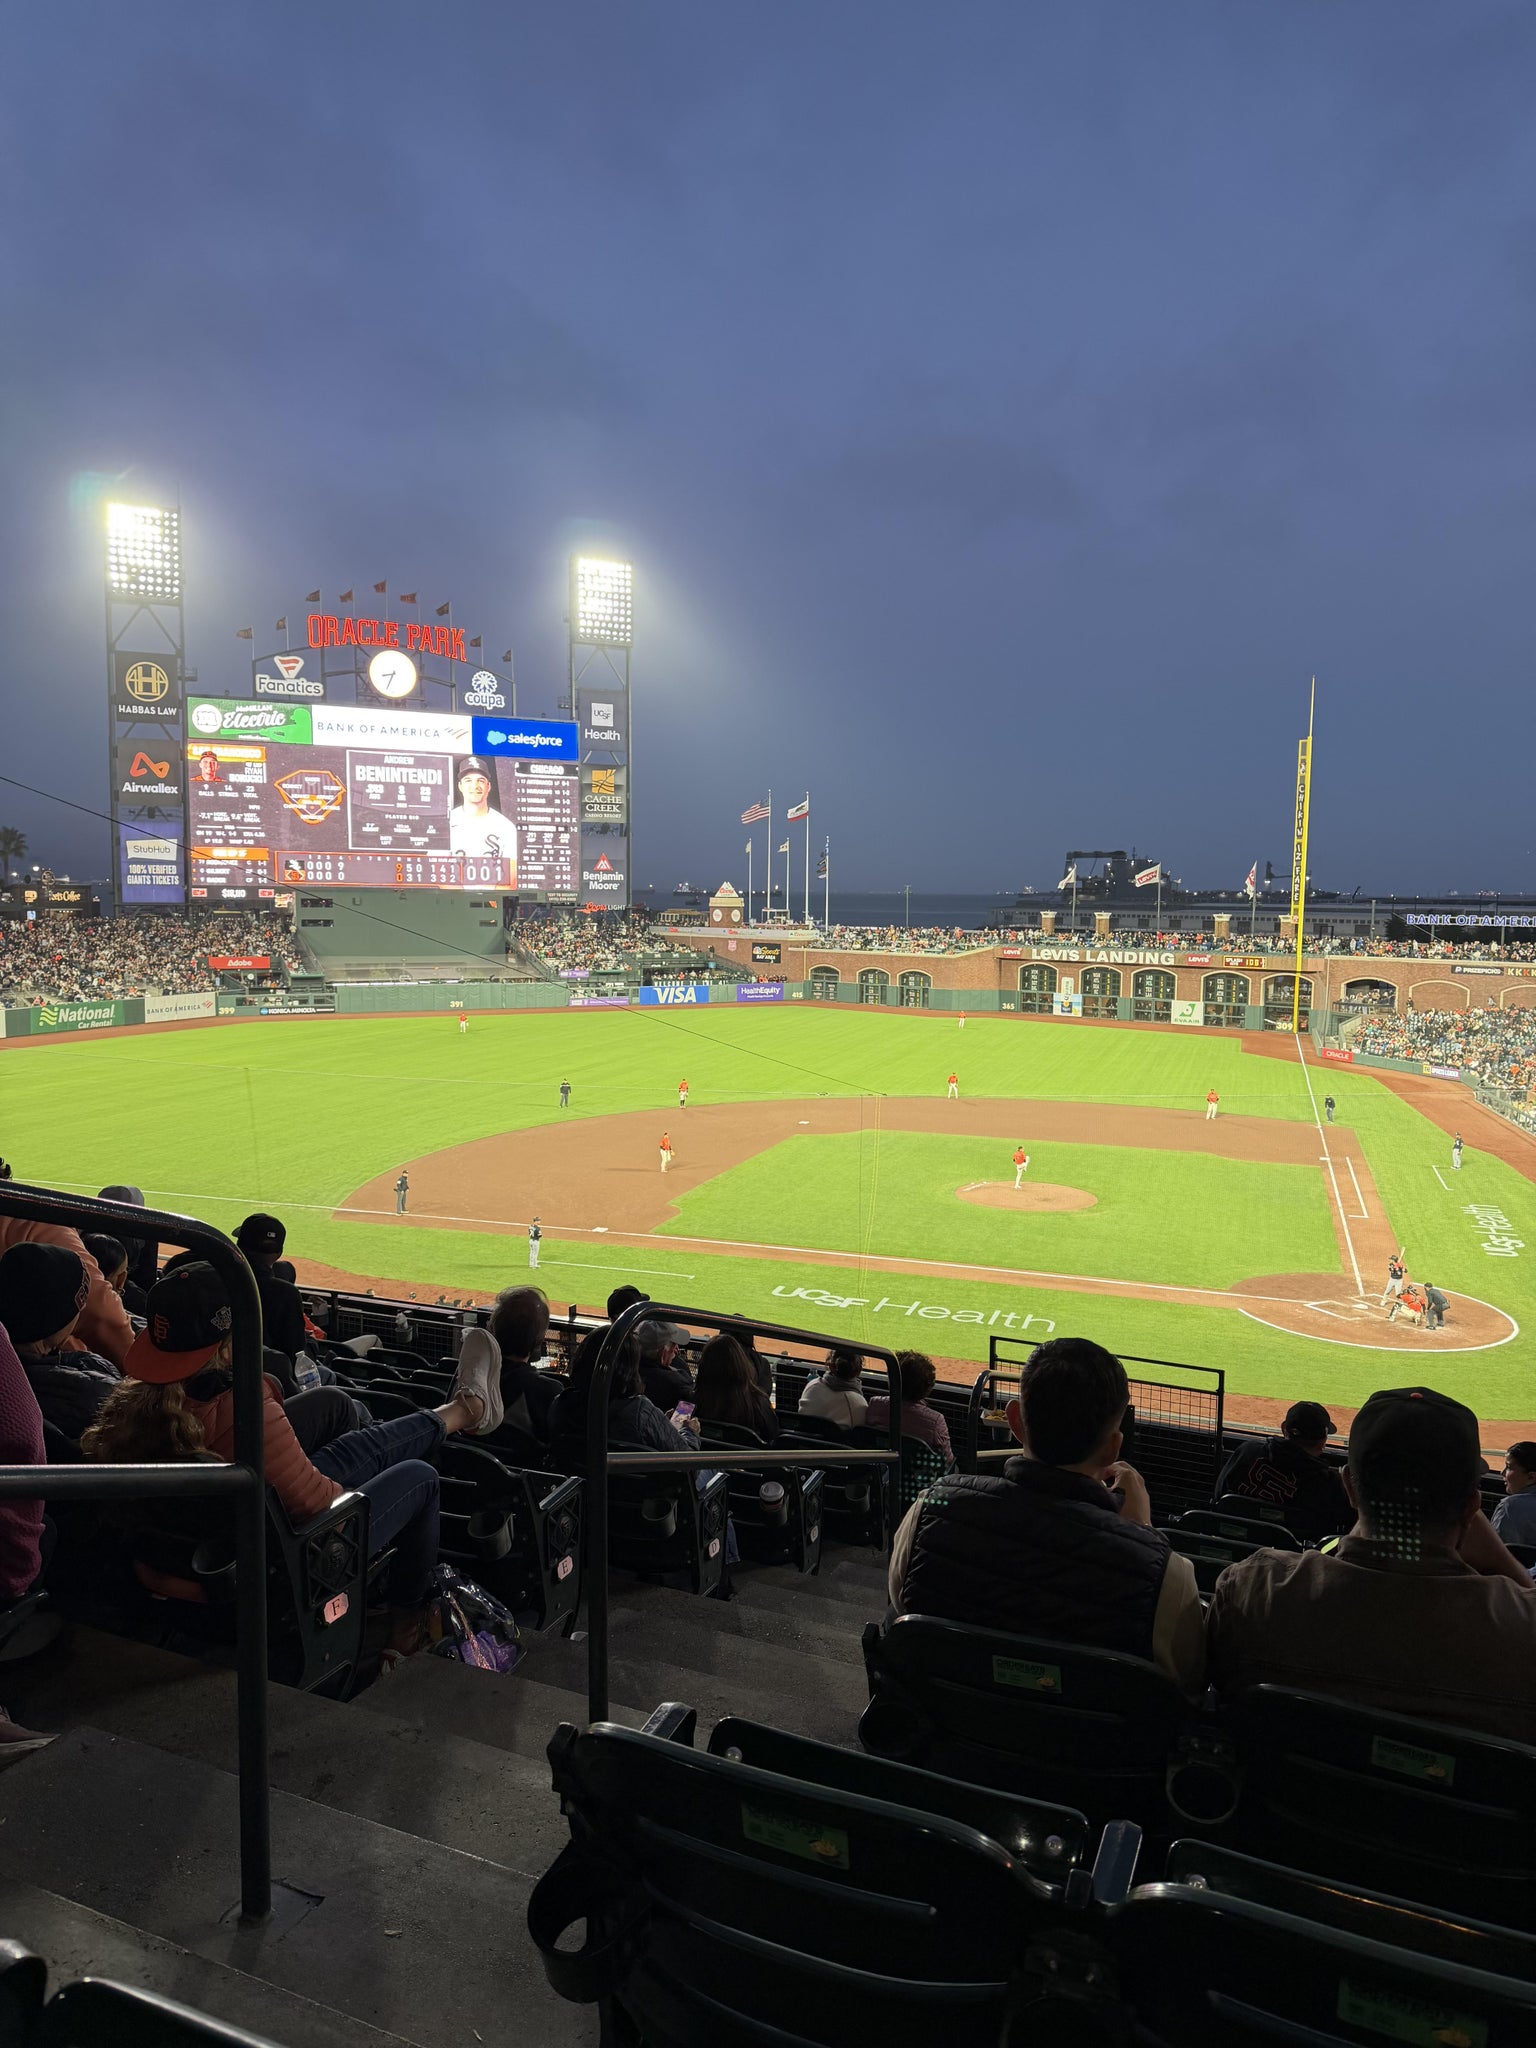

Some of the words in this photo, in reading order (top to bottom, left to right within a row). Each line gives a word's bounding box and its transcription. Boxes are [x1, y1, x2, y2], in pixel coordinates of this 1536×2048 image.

[307, 614, 399, 648] ORACLE
[406, 624, 466, 662] PARK
[258, 678, 321, 694] Fanatics
[466, 694, 504, 708] coupa
[118, 704, 156, 715] HABBAS
[158, 707, 177, 715] LAW
[594, 710, 611, 720] UCSF
[223, 710, 286, 728] Electric
[318, 722, 354, 733] BANK
[360, 724, 376, 734] OF
[380, 725, 441, 738] AMERICA
[585, 729, 620, 741] Health
[508, 733, 562, 748] salesforce
[355, 765, 442, 785] BENINTENDI
[530, 765, 564, 775] CHICAGO
[122, 782, 178, 794] Airwallex
[585, 795, 622, 803] CACHE
[586, 804, 621, 812] CREEK
[1296, 784, 1305, 837] CHIKIN
[133, 846, 170, 854] StubHub
[1296, 843, 1302, 860] IZ
[128, 865, 147, 874] 100%
[148, 865, 177, 874] VERIFIED
[307, 861, 313, 870] 0
[316, 861, 322, 870] 0
[325, 862, 332, 871] 0
[338, 862, 344, 871] 9
[396, 864, 402, 872] 9
[406, 864, 412, 873] 5
[416, 864, 422, 873] 0
[431, 865, 435, 873] 1
[440, 865, 446, 874] 4
[450, 865, 455, 874] 1
[466, 866, 476, 881] 0
[480, 866, 490, 881] 0
[495, 866, 502, 881] 1
[127, 875, 151, 885] GIANTS
[153, 875, 179, 885] TICKETS
[325, 872, 332, 880] 0
[338, 872, 344, 881] 0
[407, 874, 413, 882] 3
[417, 874, 422, 882] 1
[430, 874, 437, 882] 3
[440, 874, 446, 882] 3
[450, 874, 456, 883] 2
[583, 872, 624, 882] Benjamin
[589, 881, 618, 890] Moore
[64, 891, 80, 902] Coffee
[586, 902, 607, 911] Coors
[1407, 914, 1452, 925] BANK
[1456, 915, 1477, 925] OF
[1086, 950, 1174, 965] LANDING
[653, 987, 697, 1003] VISA
[741, 987, 780, 995] HealthEquity
[58, 1004, 114, 1023] National
[174, 1004, 201, 1012] AMERICA
[91, 1019, 113, 1028] Rental
[1326, 1051, 1349, 1060] ORACLE
[771, 1286, 870, 1308] UCSF
[873, 1297, 1056, 1332] Health
[712, 1542, 717, 1553] D
[562, 1561, 569, 1574] E
[332, 1599, 340, 1616] F
